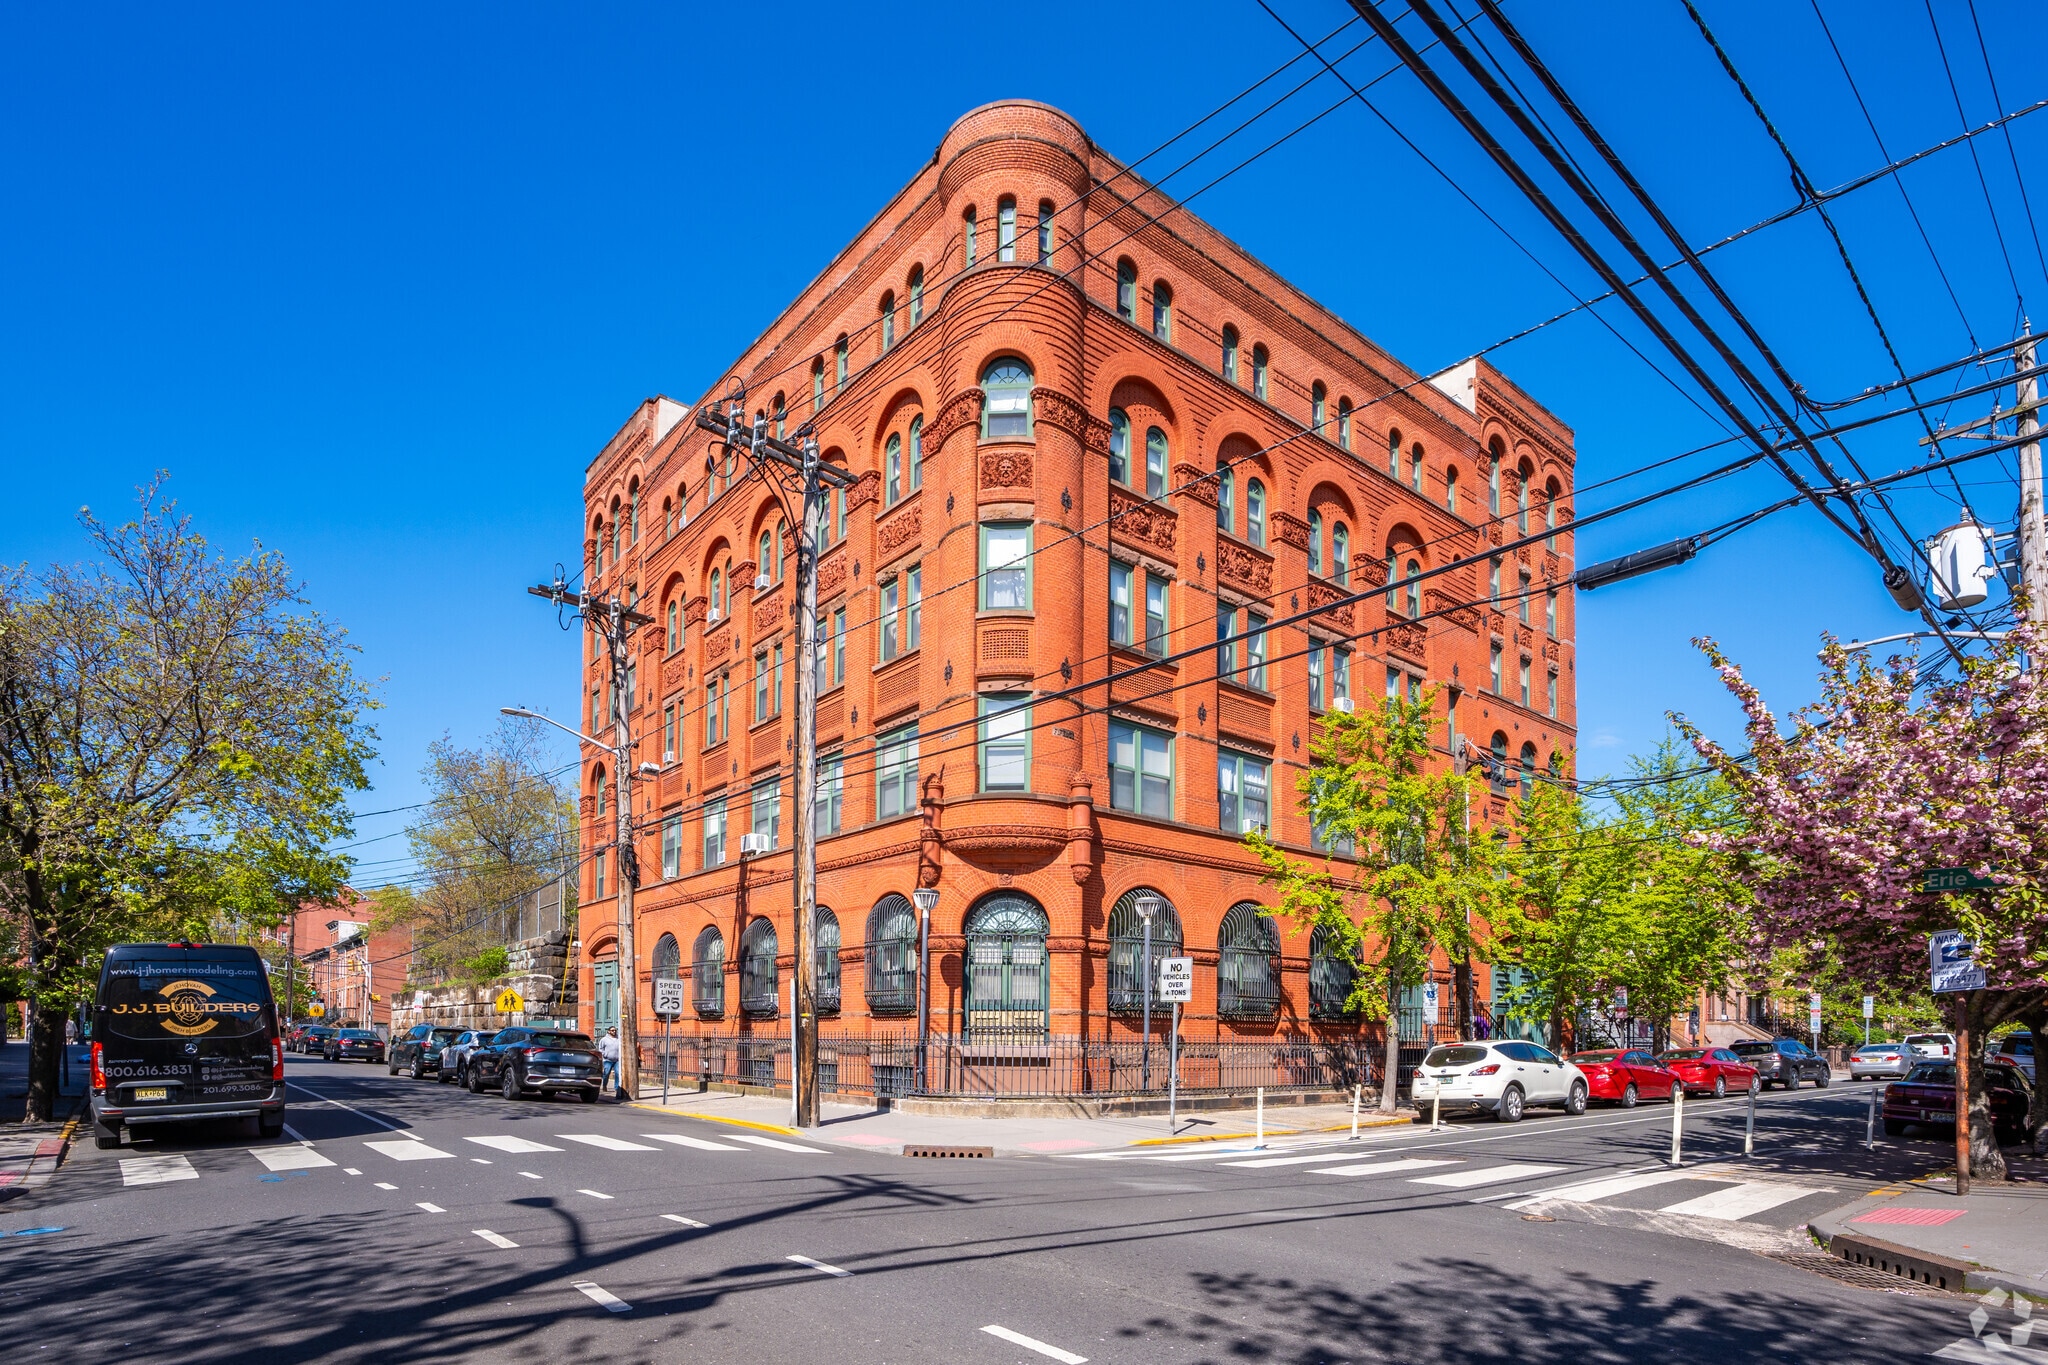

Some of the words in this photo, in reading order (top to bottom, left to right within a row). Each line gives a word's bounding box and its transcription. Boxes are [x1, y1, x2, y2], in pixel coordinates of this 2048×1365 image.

[1928, 872, 1967, 887] Erie
[111, 964, 257, 976] www.j-jhomeremodeling.com
[1170, 964, 1182, 972] NO
[153, 1002, 261, 1014] BUILDERS
[660, 997, 680, 1009] 25
[185, 1023, 212, 1034] BUILDERS
[105, 1064, 192, 1078] 800.616.3831
[203, 1084, 261, 1094] 201.699.3086
